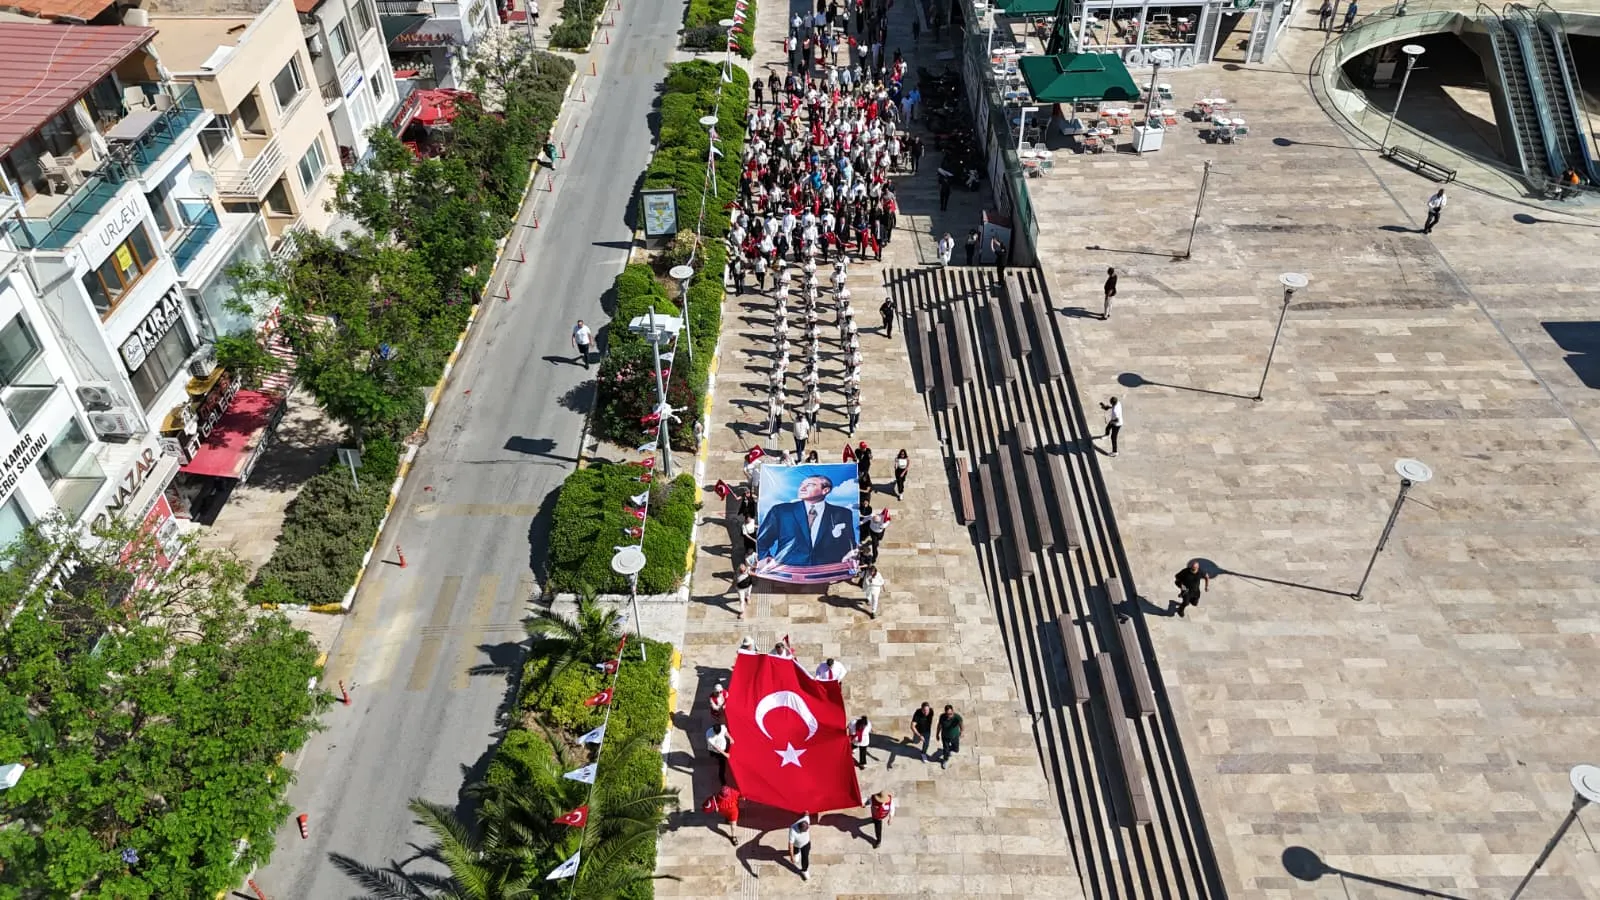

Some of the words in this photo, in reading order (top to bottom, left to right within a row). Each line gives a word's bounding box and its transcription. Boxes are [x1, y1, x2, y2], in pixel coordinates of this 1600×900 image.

[135, 284, 182, 345] KIRAN
[3, 433, 33, 471] KAMAR
[16, 433, 48, 474] SALONU
[187, 432, 201, 460] ET
